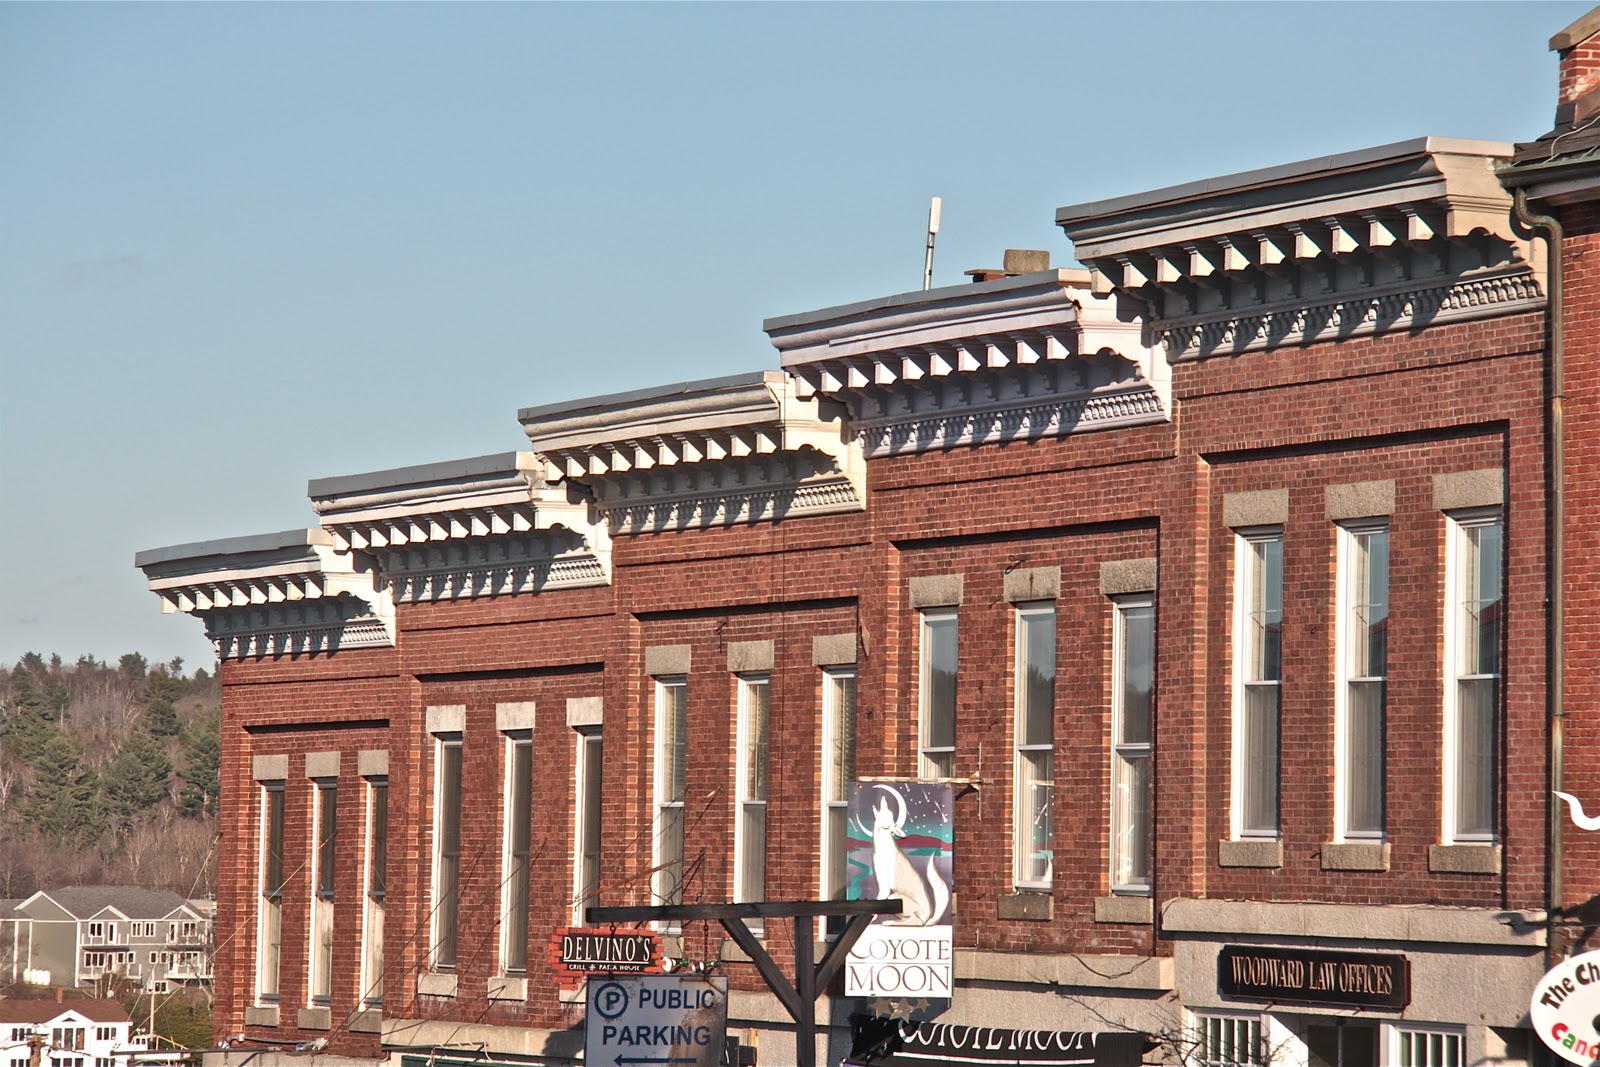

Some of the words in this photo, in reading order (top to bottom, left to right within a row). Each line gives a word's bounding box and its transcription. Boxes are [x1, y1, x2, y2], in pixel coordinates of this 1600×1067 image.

[849, 965, 950, 992] MOON
[1231, 955, 1304, 988] WOODWARD
[1309, 961, 1338, 991] LAW
[1338, 962, 1393, 995] OFFICES
[606, 991, 621, 1011] P
[639, 989, 715, 1010] PUBLIC
[1540, 977, 1575, 1010] The
[602, 1025, 711, 1046] PARKING
